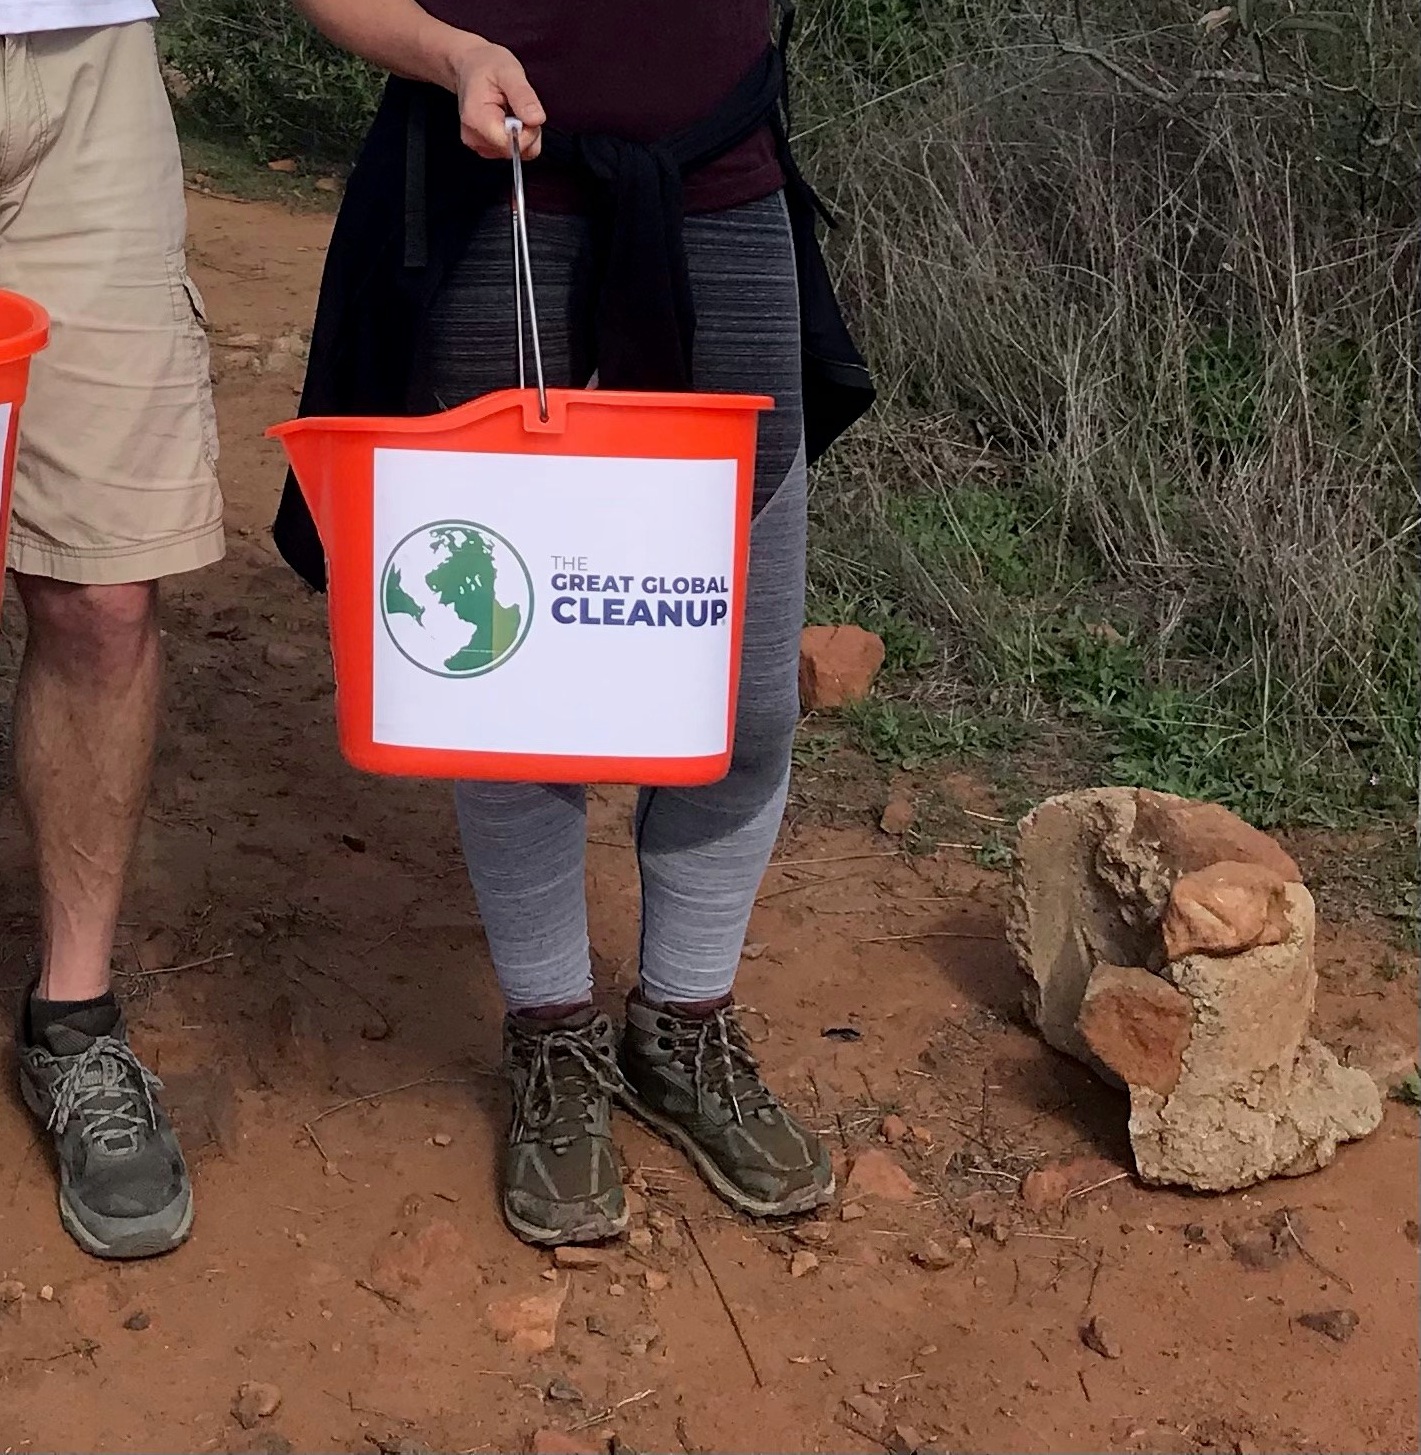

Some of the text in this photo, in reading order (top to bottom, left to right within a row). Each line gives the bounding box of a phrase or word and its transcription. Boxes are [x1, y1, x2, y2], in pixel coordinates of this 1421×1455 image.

[550, 555, 589, 571] THE
[550, 573, 729, 594] GREAT GLOBAL
[551, 596, 728, 627] CLEANUP
